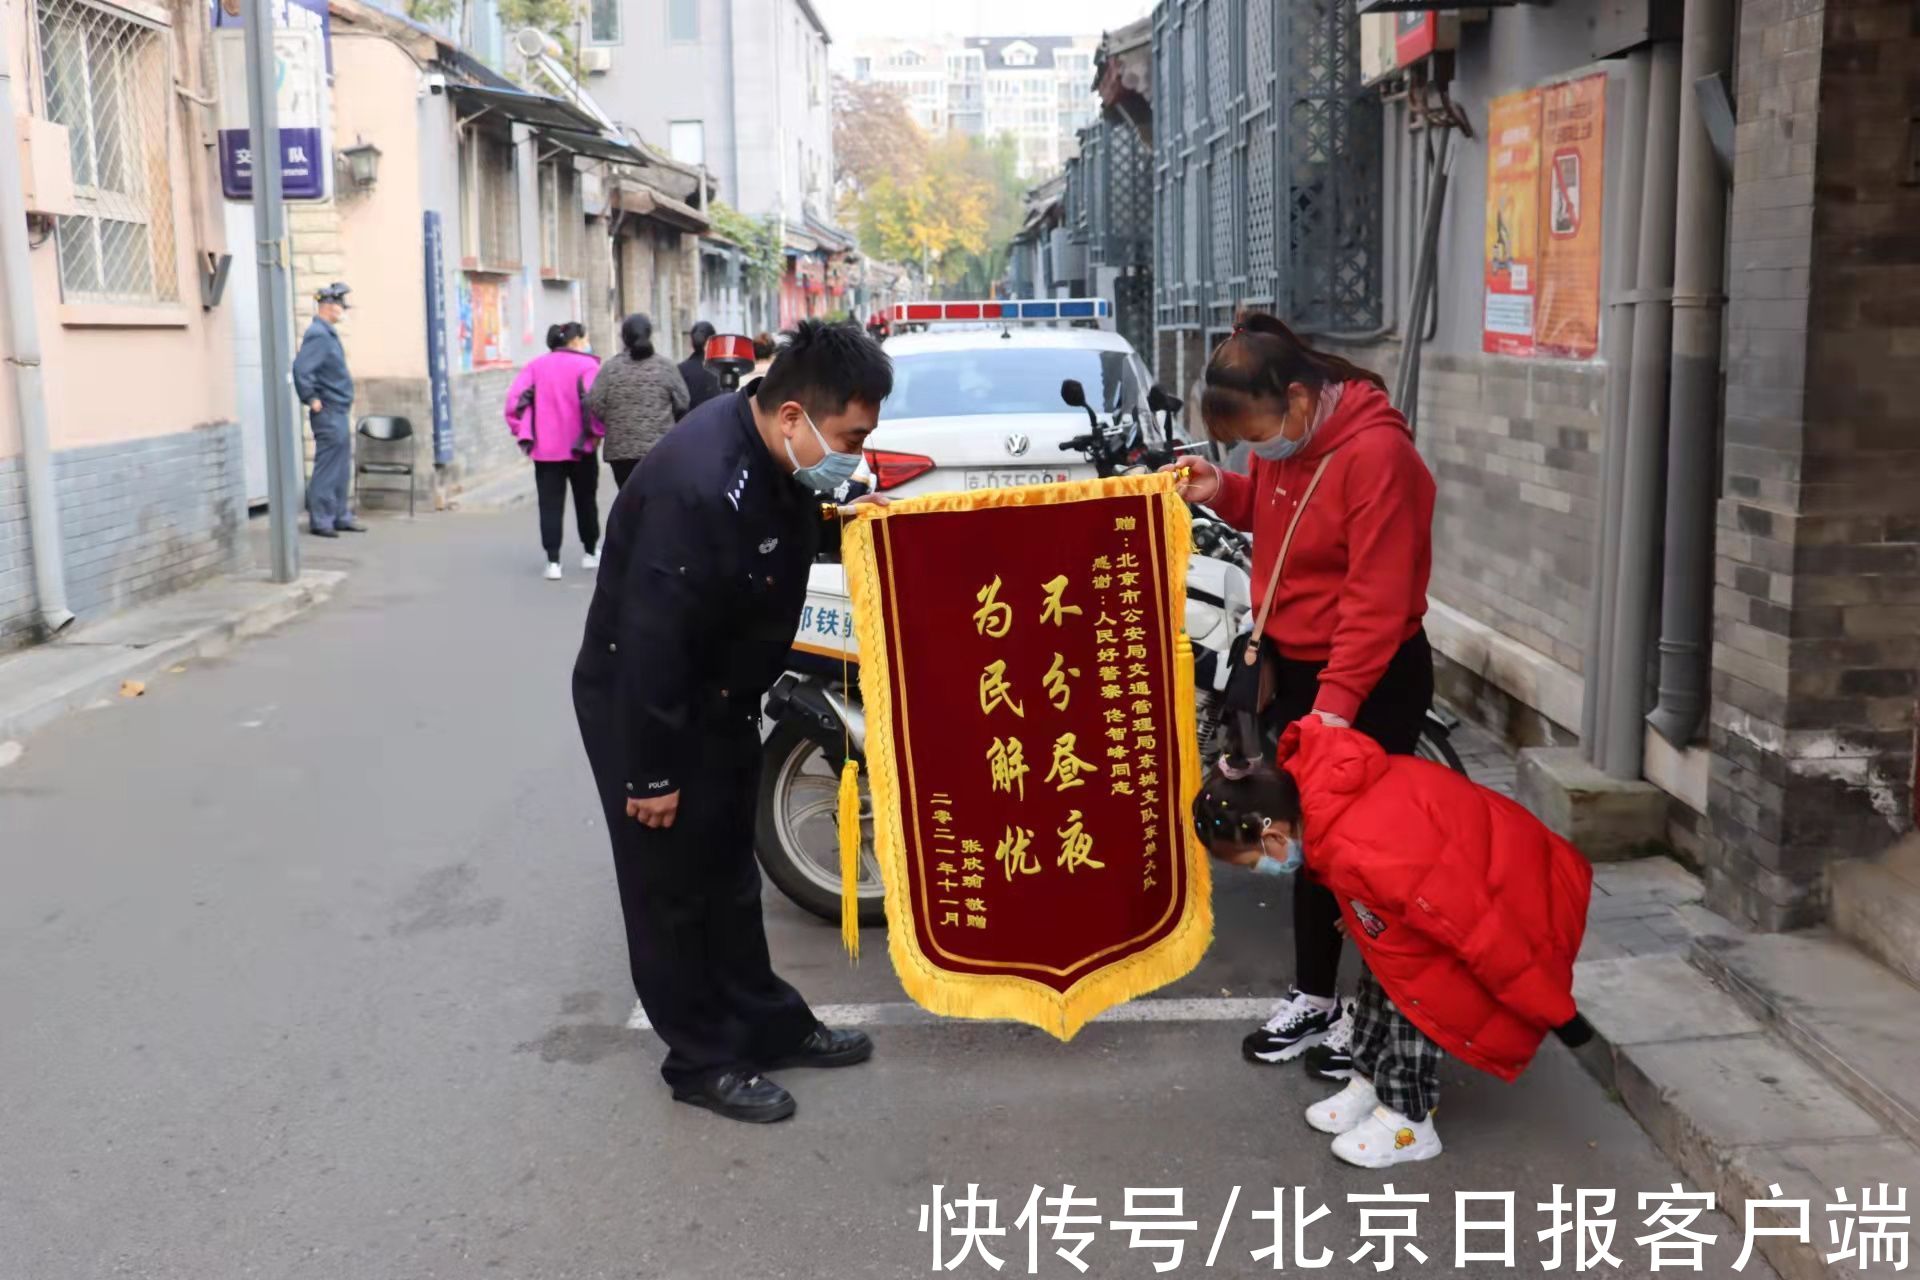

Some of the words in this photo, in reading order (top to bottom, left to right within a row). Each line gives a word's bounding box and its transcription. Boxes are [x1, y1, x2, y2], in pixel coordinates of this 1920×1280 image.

[930, 792, 960, 928] 二零二一年十一月
[972, 574, 1042, 882] 为民解忧
[1039, 574, 1105, 874] 不分昼夜
